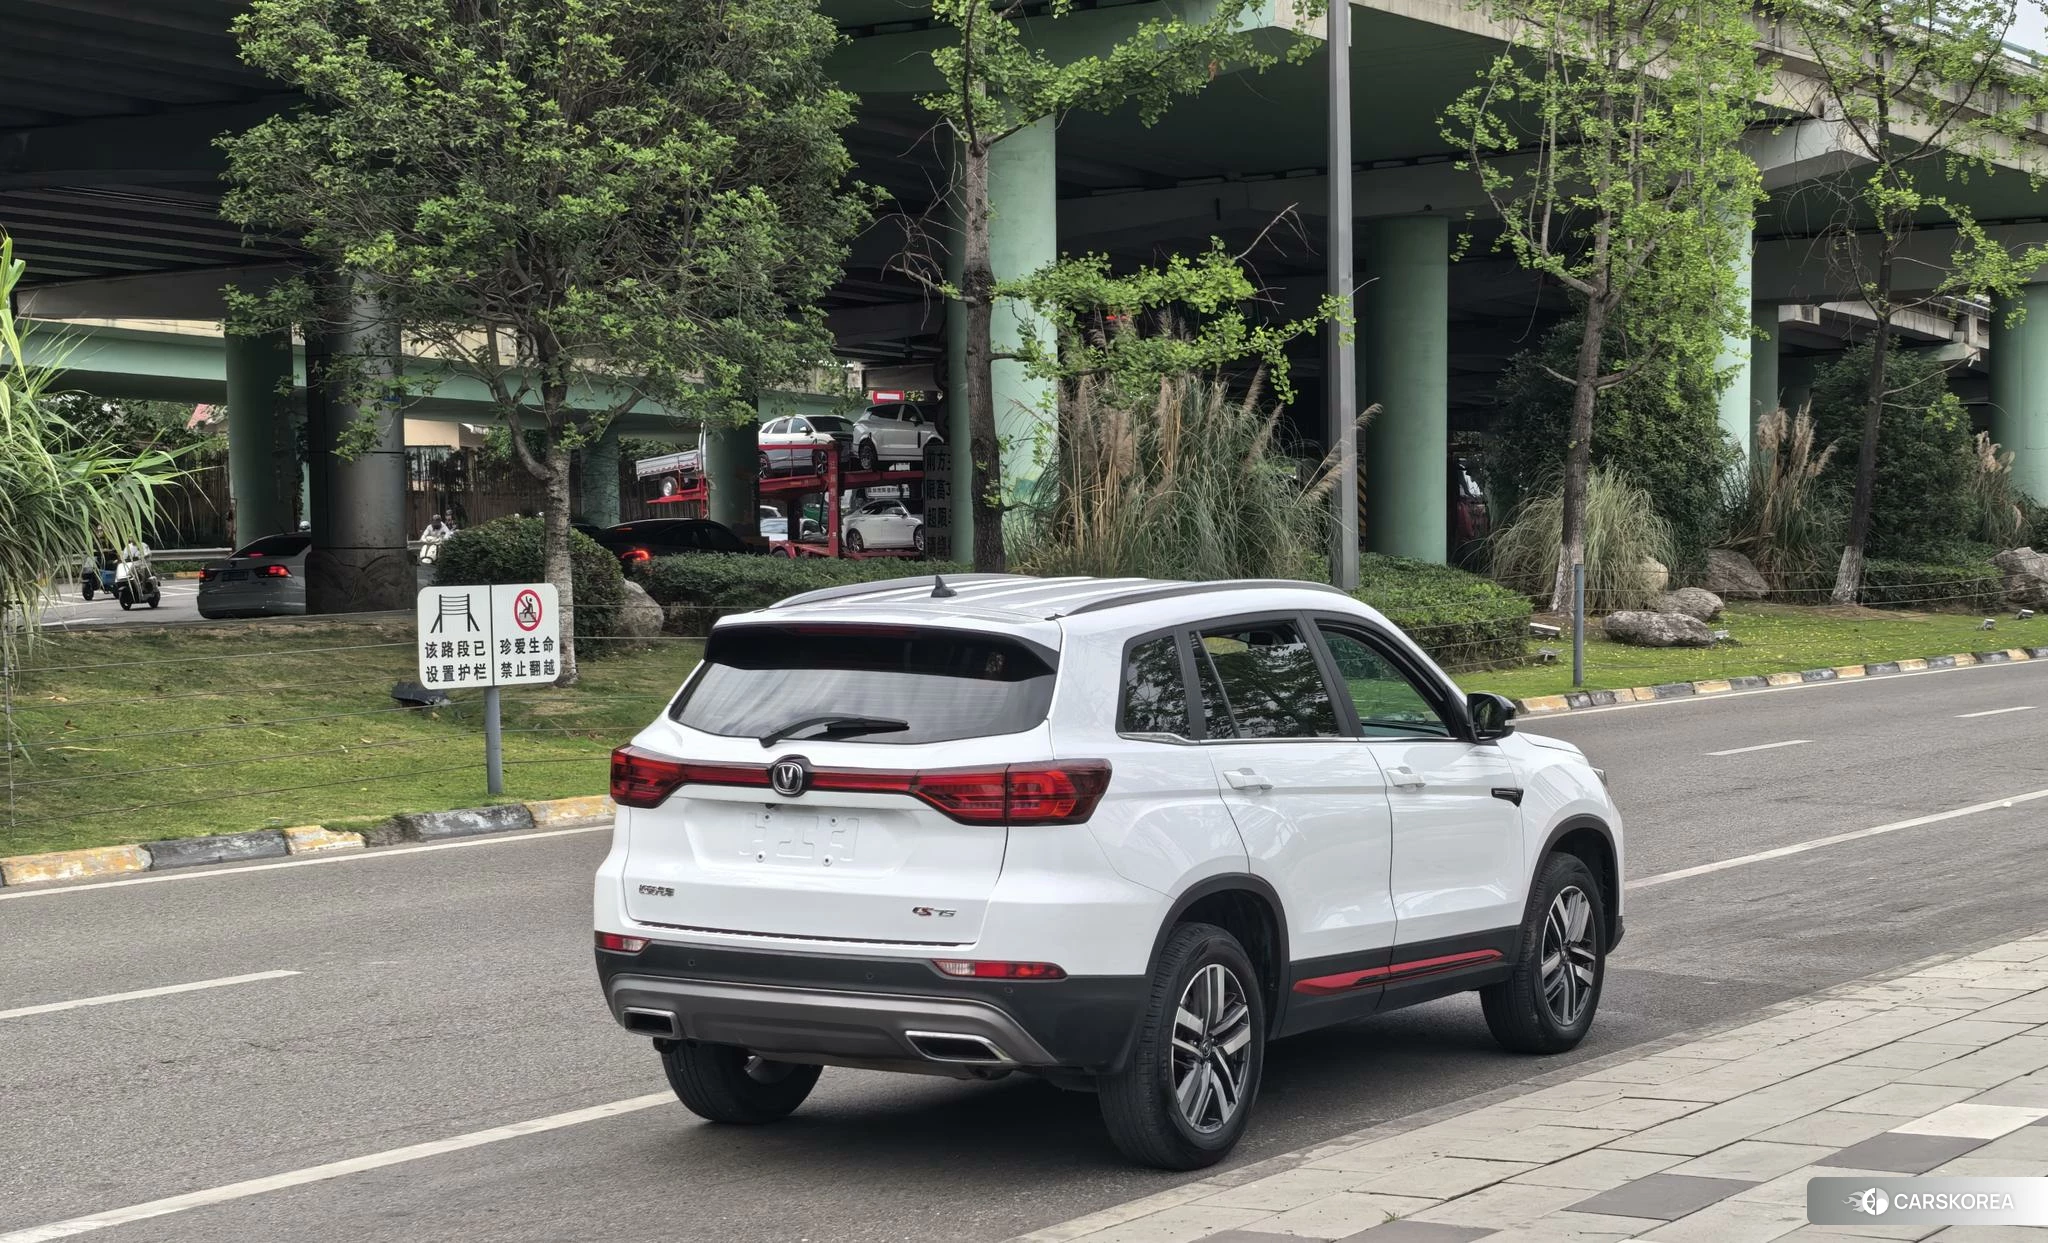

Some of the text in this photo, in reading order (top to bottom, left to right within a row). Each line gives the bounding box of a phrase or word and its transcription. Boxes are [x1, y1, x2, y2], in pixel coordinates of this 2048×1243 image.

[425, 640, 486, 659] 该路段已
[500, 636, 554, 655] 珍爱生命
[426, 663, 487, 683] 设置护栏
[501, 659, 555, 678] 禁止翻越
